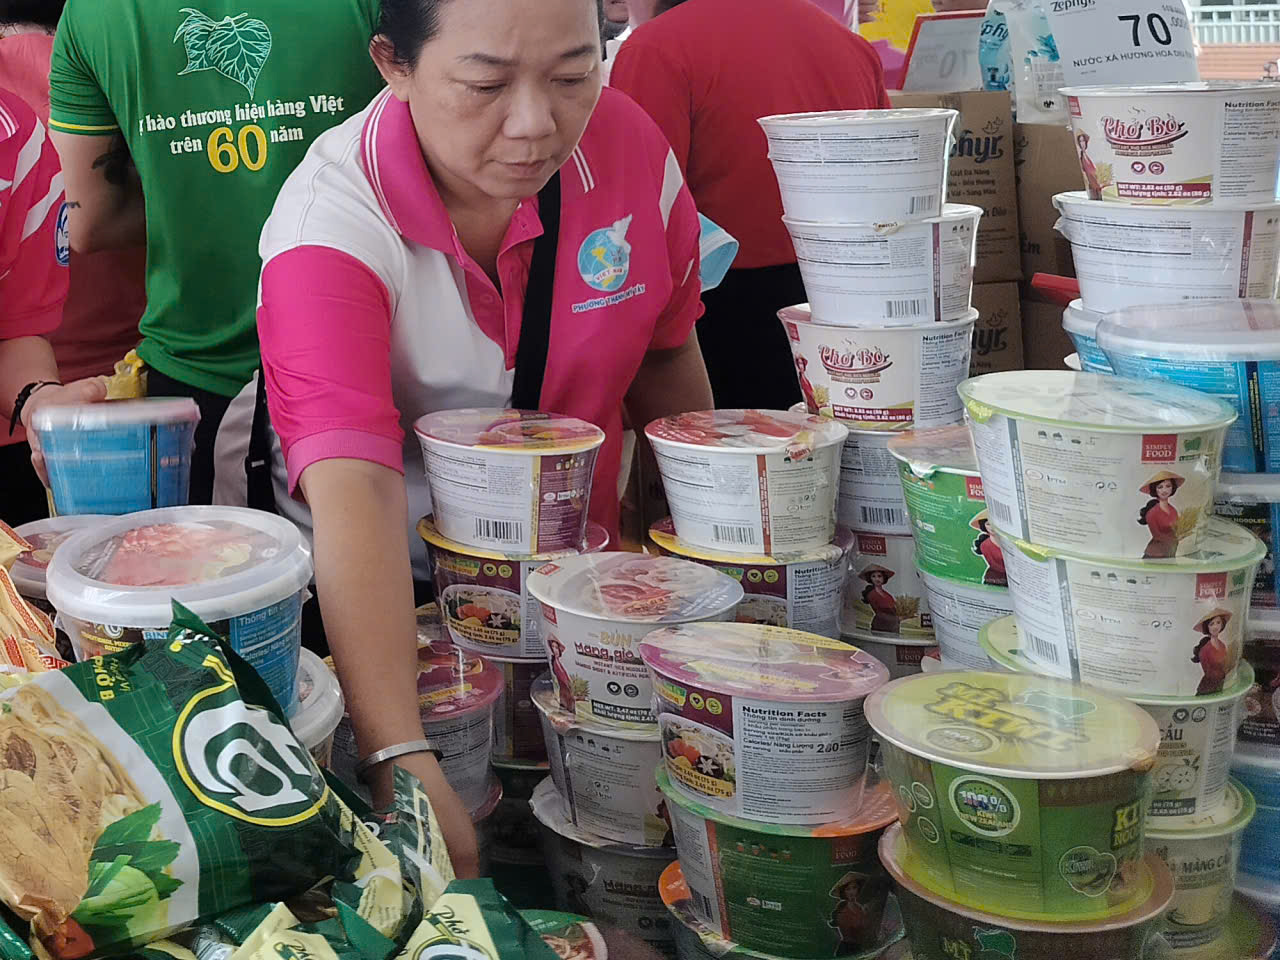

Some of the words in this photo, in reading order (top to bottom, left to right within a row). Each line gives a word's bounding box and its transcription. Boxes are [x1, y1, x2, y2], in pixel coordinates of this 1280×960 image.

[1117, 13, 1173, 47] 70
[145, 114, 176, 132] hào
[180, 107, 233, 128] thương
[234, 103, 266, 125] hiệu
[267, 100, 307, 117] hàng
[309, 95, 345, 116] Việt
[170, 137, 203, 155] trên
[207, 124, 267, 173] 60
[270, 127, 304, 143] năm
[1145, 449, 1172, 457] FOOD
[742, 705, 794, 717] Nutrition
